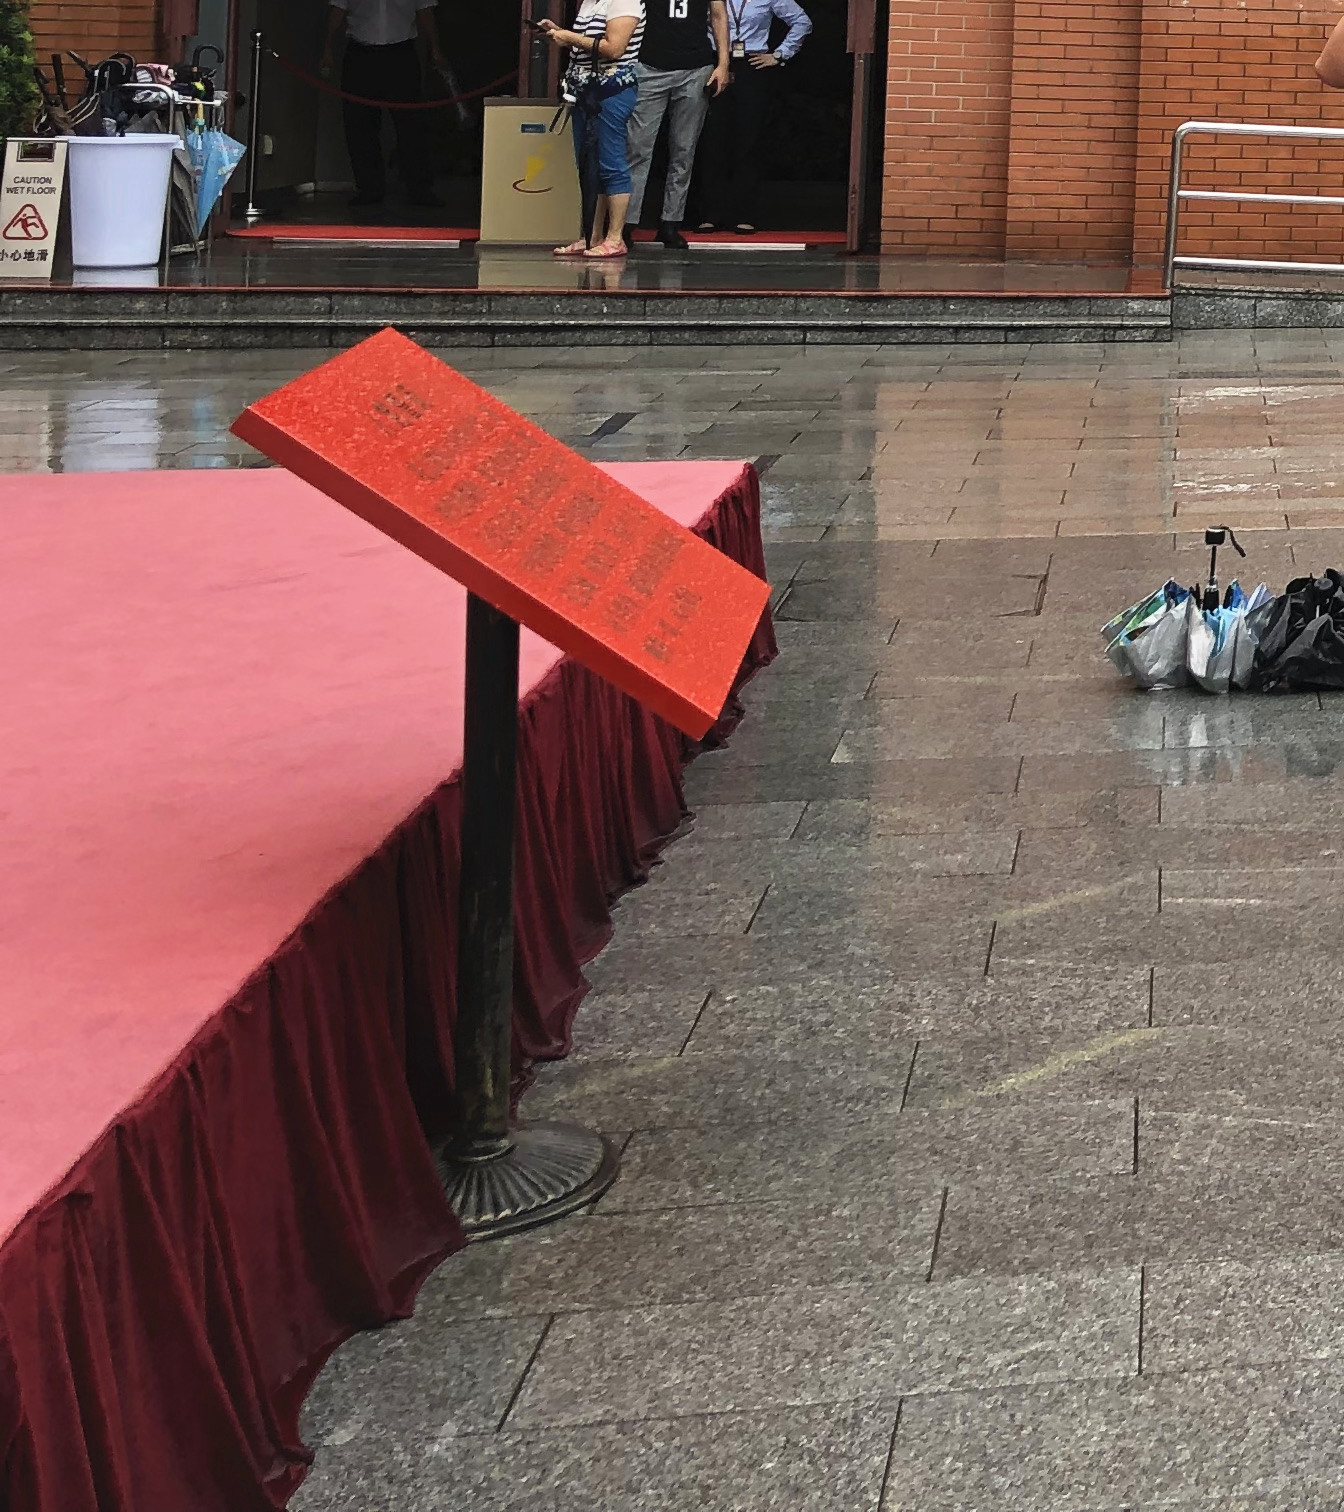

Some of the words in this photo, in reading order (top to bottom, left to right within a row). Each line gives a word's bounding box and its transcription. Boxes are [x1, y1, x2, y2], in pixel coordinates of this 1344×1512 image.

[13, 176, 52, 185] CAUTION
[6, 187, 24, 195] WET
[27, 187, 57, 195] FLOOR
[0, 248, 48, 262] 小心地滑
